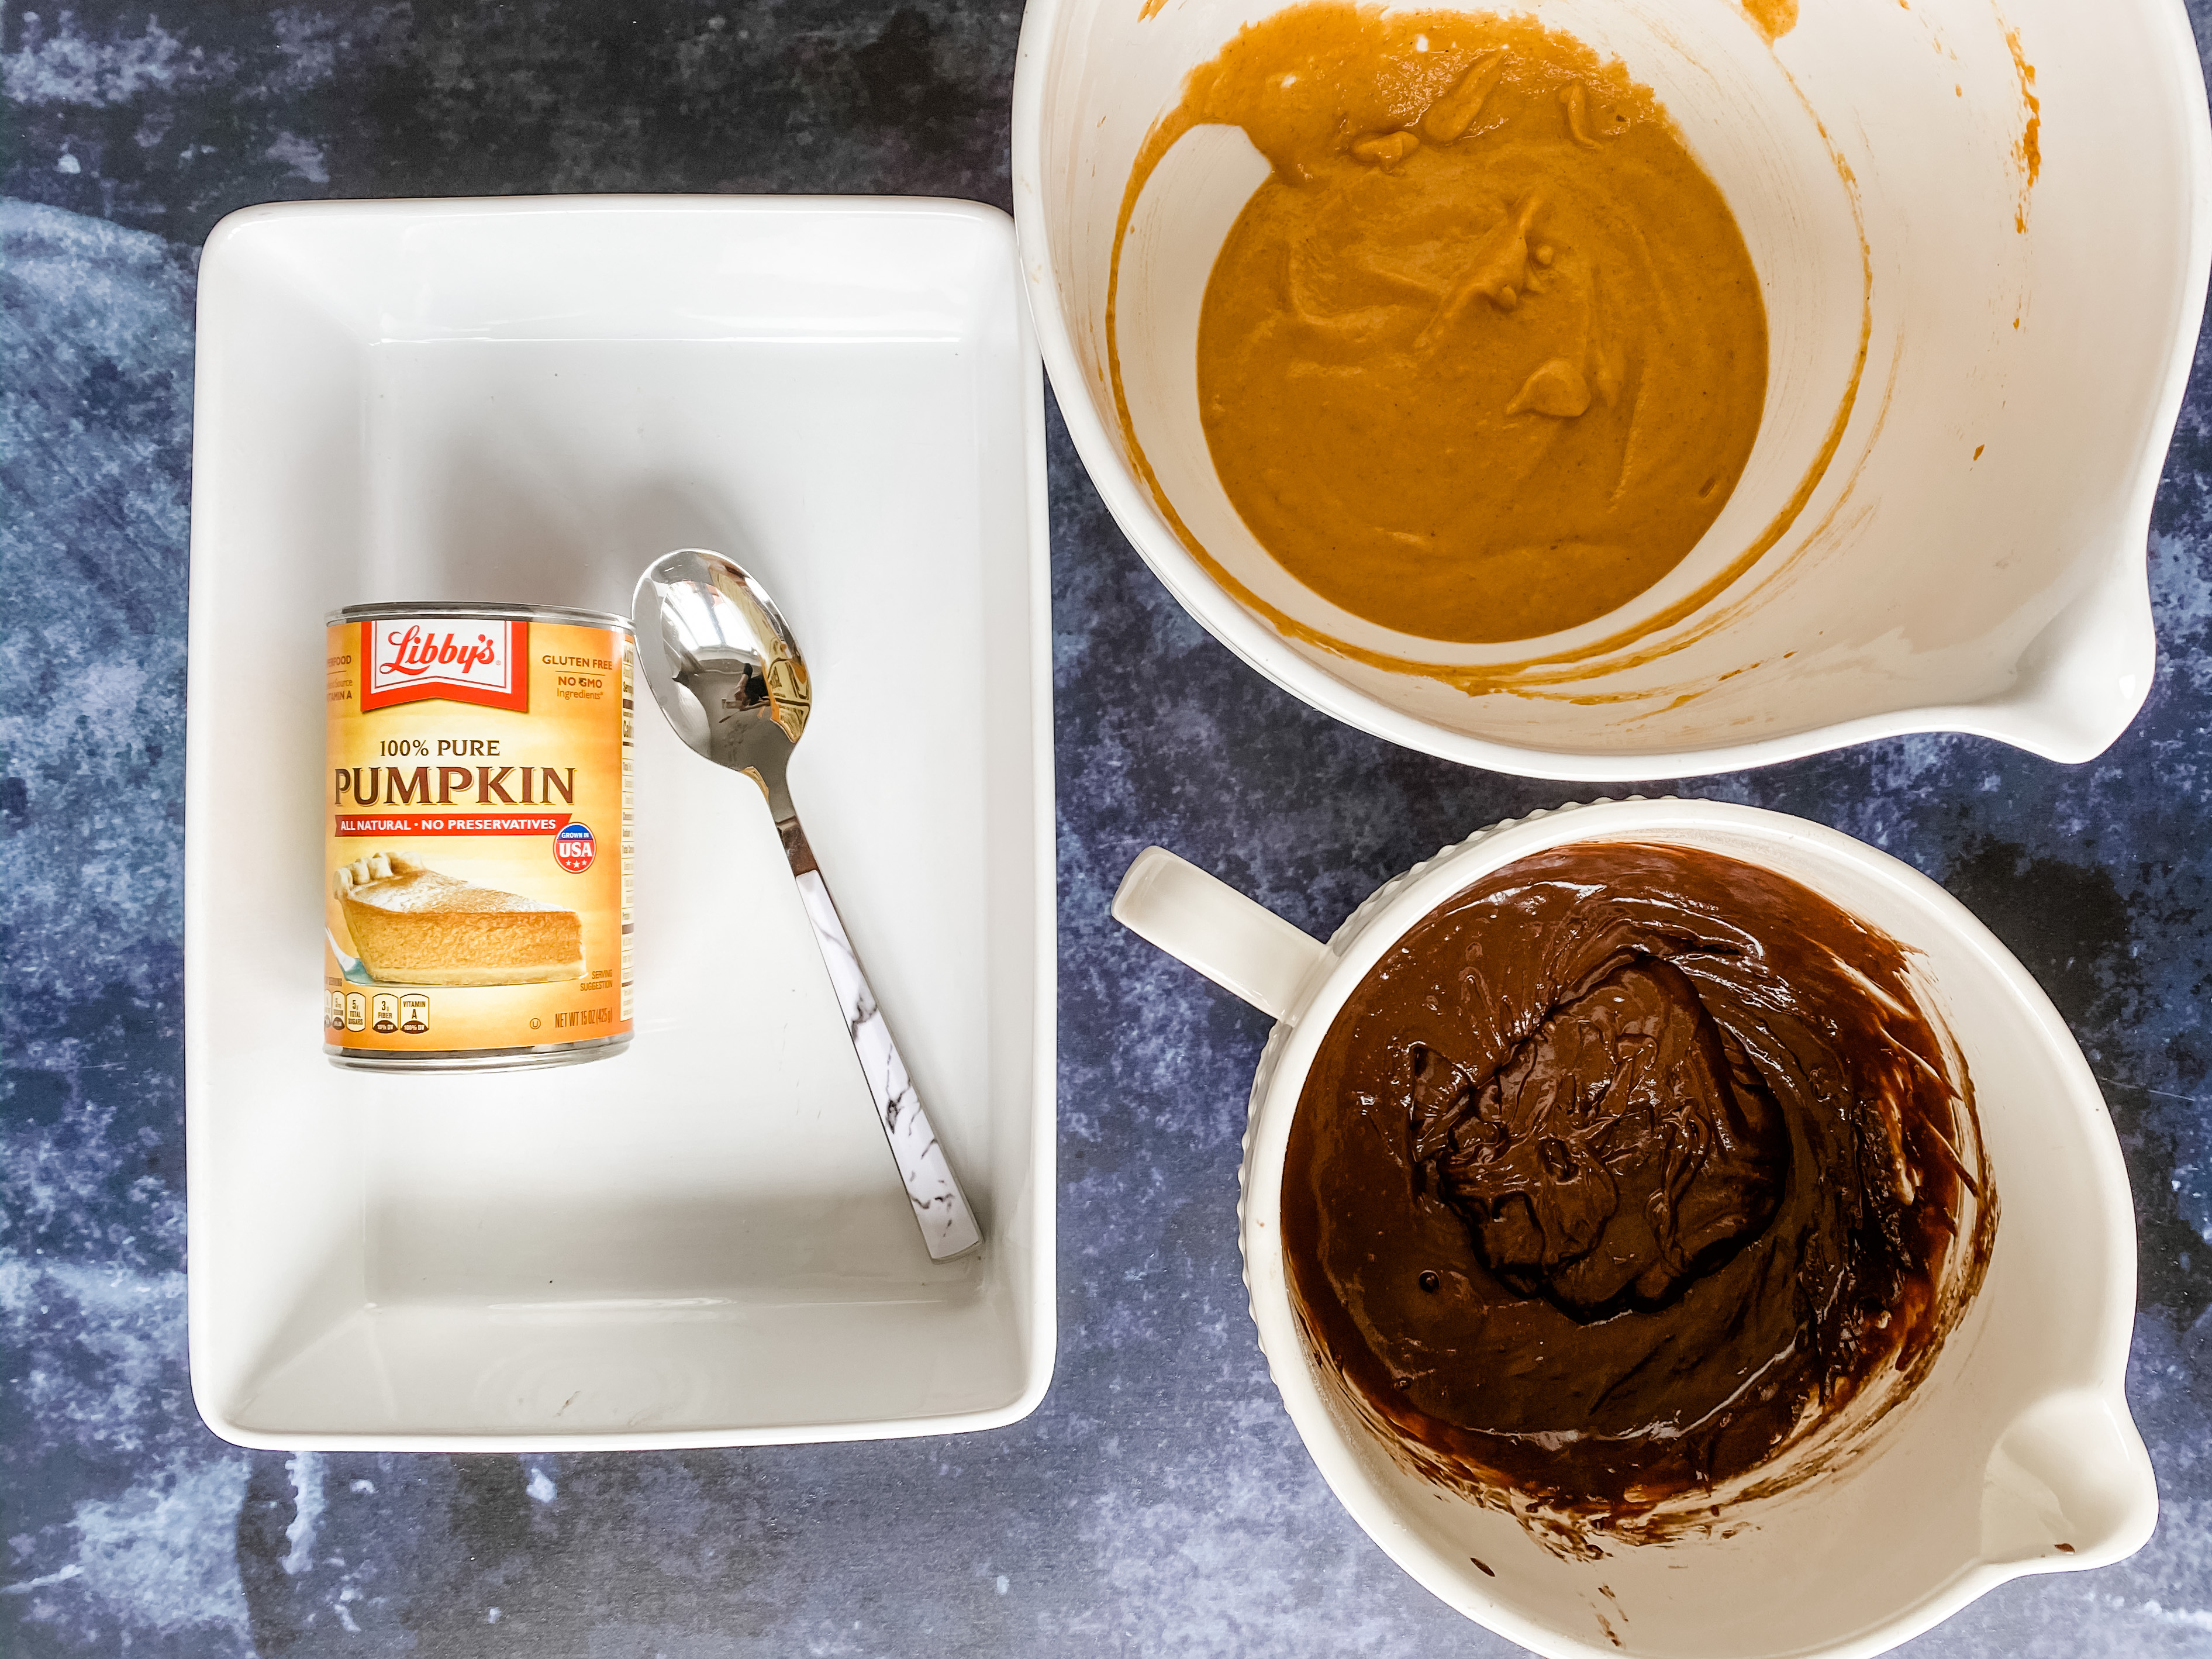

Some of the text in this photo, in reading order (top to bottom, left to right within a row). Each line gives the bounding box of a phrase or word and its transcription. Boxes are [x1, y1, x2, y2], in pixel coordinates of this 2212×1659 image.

[379, 625, 495, 675] Libby's
[542, 655, 613, 670] GLUTEN FREE
[558, 676, 576, 687] NO
[380, 739, 501, 757] 100% PURE
[334, 766, 577, 806] PUMPKIN
[340, 819, 556, 831] ALL NATURAL NO PRESERVATIVES
[558, 841, 593, 858] USA
[592, 970, 613, 979] SERVING
[580, 980, 613, 991] SUGGESTION
[412, 1009, 417, 1019] A
[555, 1012, 568, 1028] NET
[568, 1011, 579, 1027] WT
[580, 1010, 587, 1025] 15
[588, 1009, 596, 1024] OZ
